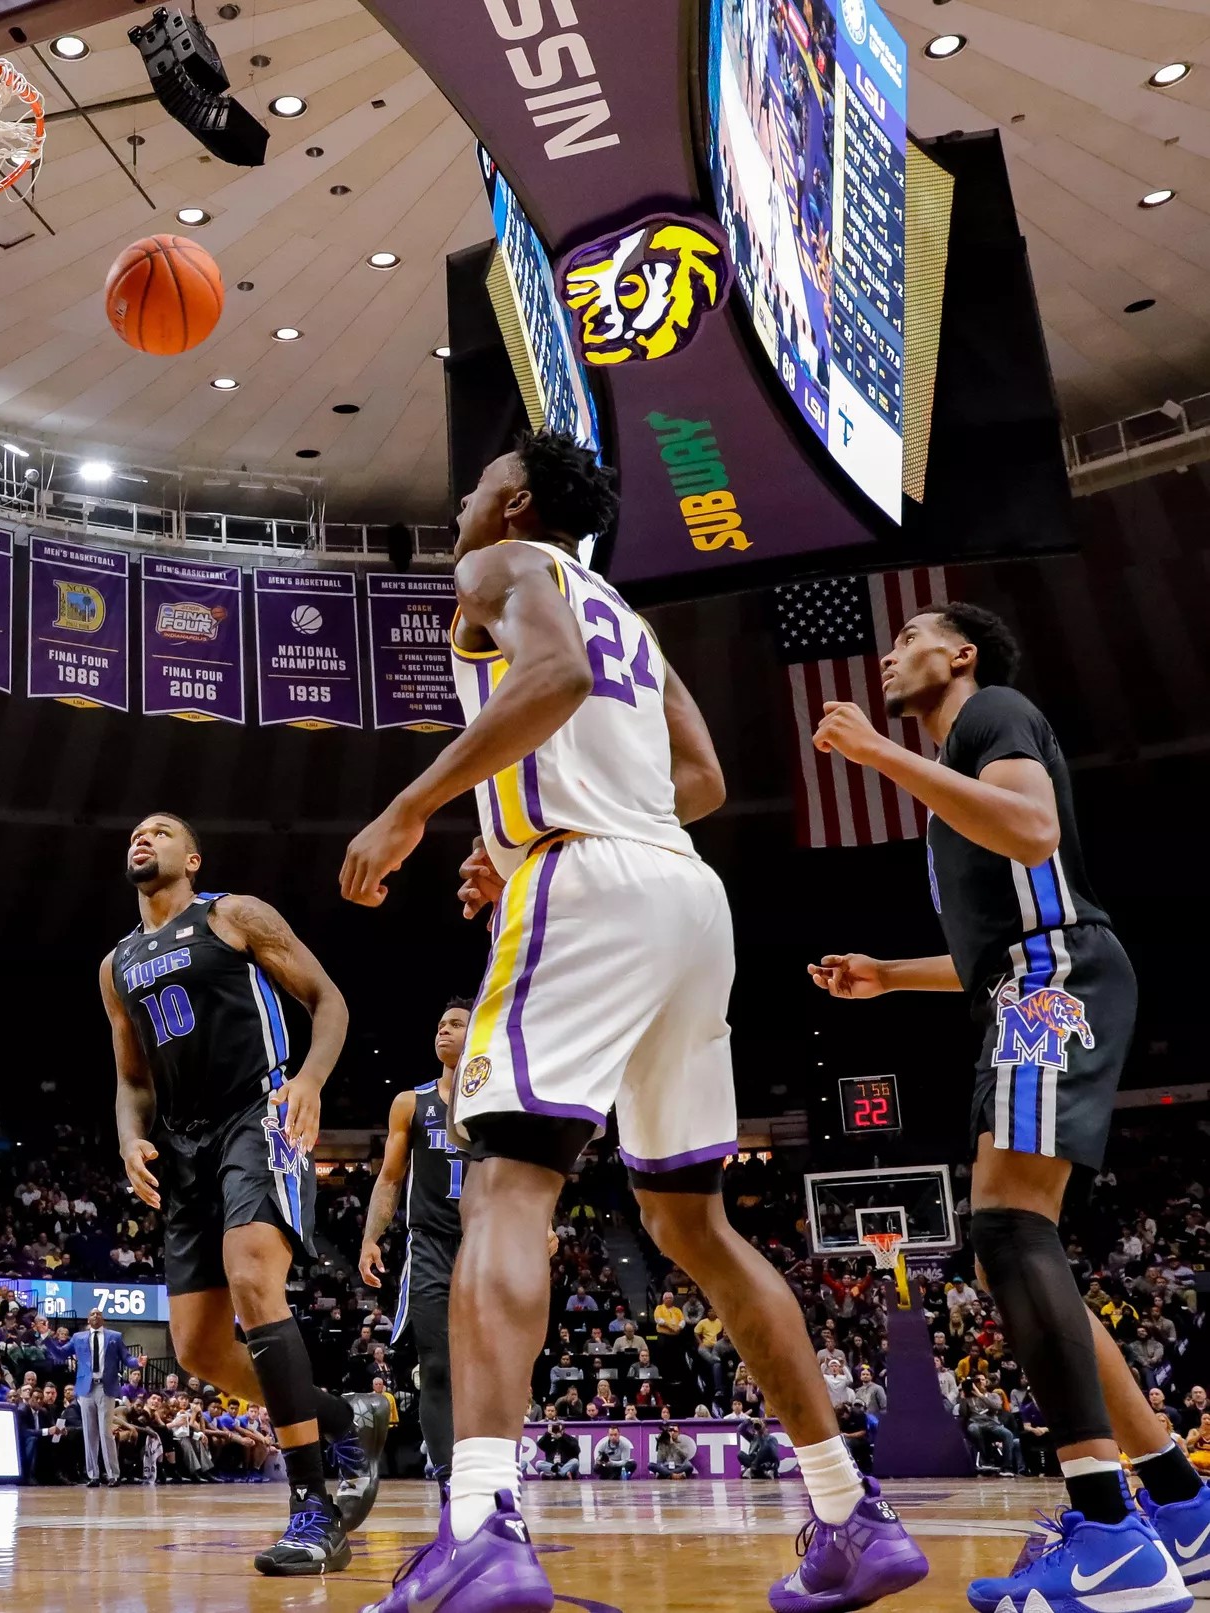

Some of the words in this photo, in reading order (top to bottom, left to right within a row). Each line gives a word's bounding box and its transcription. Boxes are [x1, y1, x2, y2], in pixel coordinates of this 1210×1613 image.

[856, 63, 886, 121] LSU
[846, 83, 870, 126] TREMONT
[870, 118, 892, 155] WATERS
[845, 158, 861, 191] DARYL
[861, 182, 887, 223] EDWARDS
[863, 262, 890, 302] WILLIAMS
[782, 350, 796, 392] 68
[803, 386, 826, 431] LSU
[642, 411, 754, 551] SUBWAY
[44, 547, 68, 558] MEN'S
[70, 552, 115, 567] BASKETBALL
[155, 564, 179, 575] MEN'S
[181, 568, 227, 581] BASKETBALL
[268, 576, 292, 585] MEN'S
[295, 578, 341, 588] BASKETBALL
[67, 584, 91, 594] NCAA
[381, 582, 406, 590] MEN'S
[408, 582, 455, 591] BASKETBALL
[175, 611, 212, 622] FINAL
[407, 604, 432, 612] COACH
[162, 618, 212, 633] FOUR
[400, 614, 441, 628] DALE
[391, 628, 451, 643] BROWN
[49, 650, 78, 664] FINAL
[82, 655, 109, 668] FOUR
[278, 645, 339, 658] NATIONAL
[163, 665, 192, 679] FINAL
[196, 669, 223, 682] FOUR
[272, 657, 346, 671] CHAMPIONS
[57, 664, 100, 687] 1986
[170, 680, 217, 701] 2006
[289, 685, 331, 703] 1935
[123, 946, 192, 994] Tigers
[139, 984, 196, 1047] 10
[990, 1005, 1068, 1073] M
[854, 1098, 888, 1126] 22
[93, 1288, 145, 1315] 7:56
